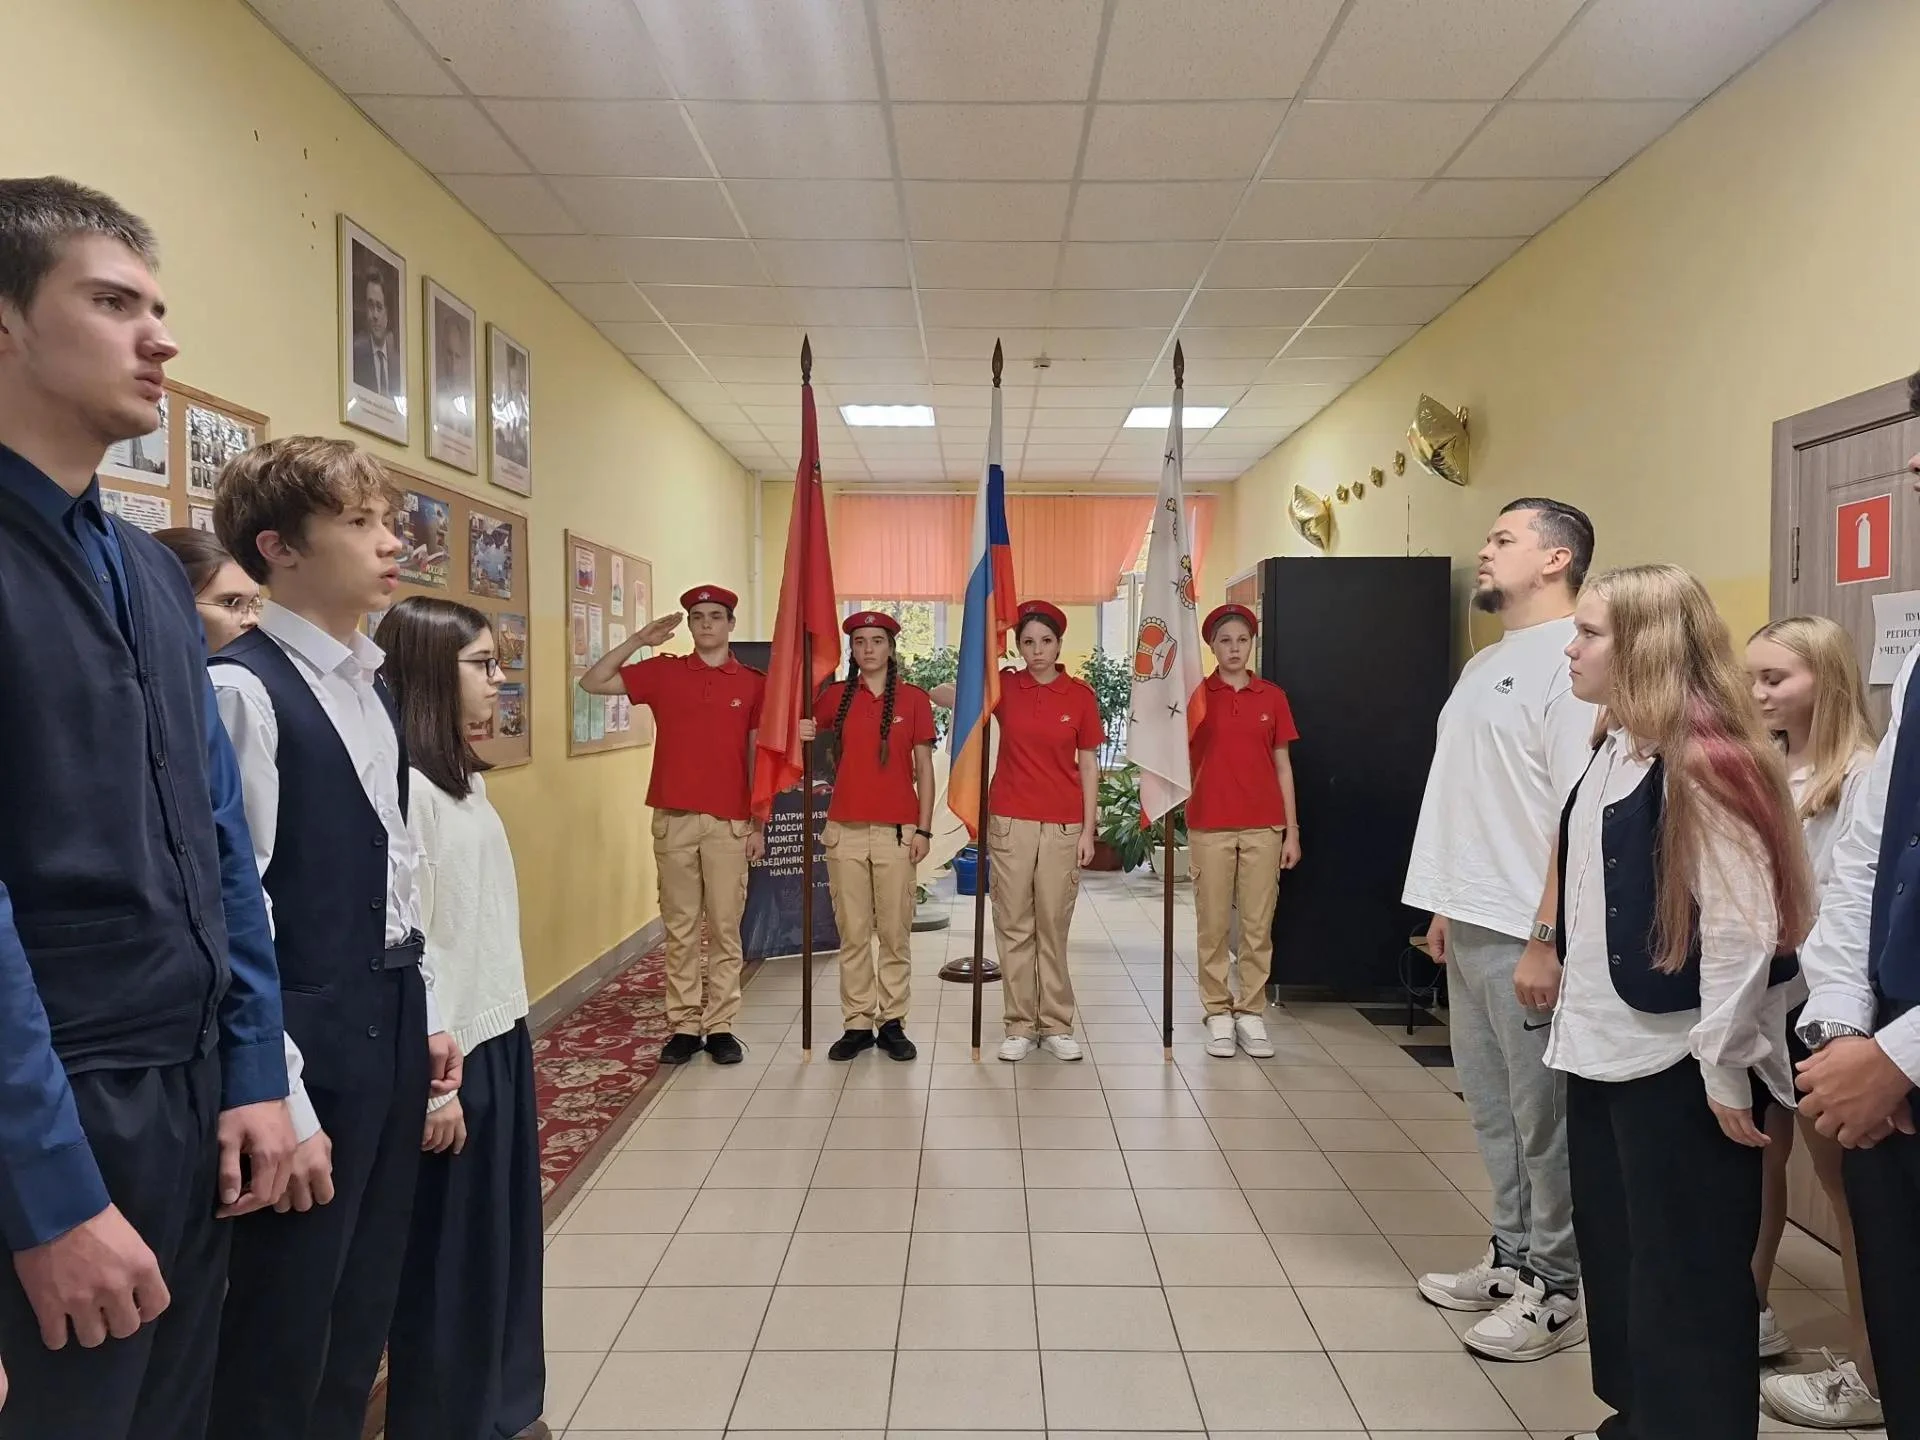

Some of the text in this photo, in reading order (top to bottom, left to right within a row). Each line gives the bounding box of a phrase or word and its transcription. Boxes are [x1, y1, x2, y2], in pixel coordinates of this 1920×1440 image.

[768, 825, 773, 833] У
[768, 835, 798, 844] МОЖЕТ
[770, 867, 804, 876] НАЧАЛА
